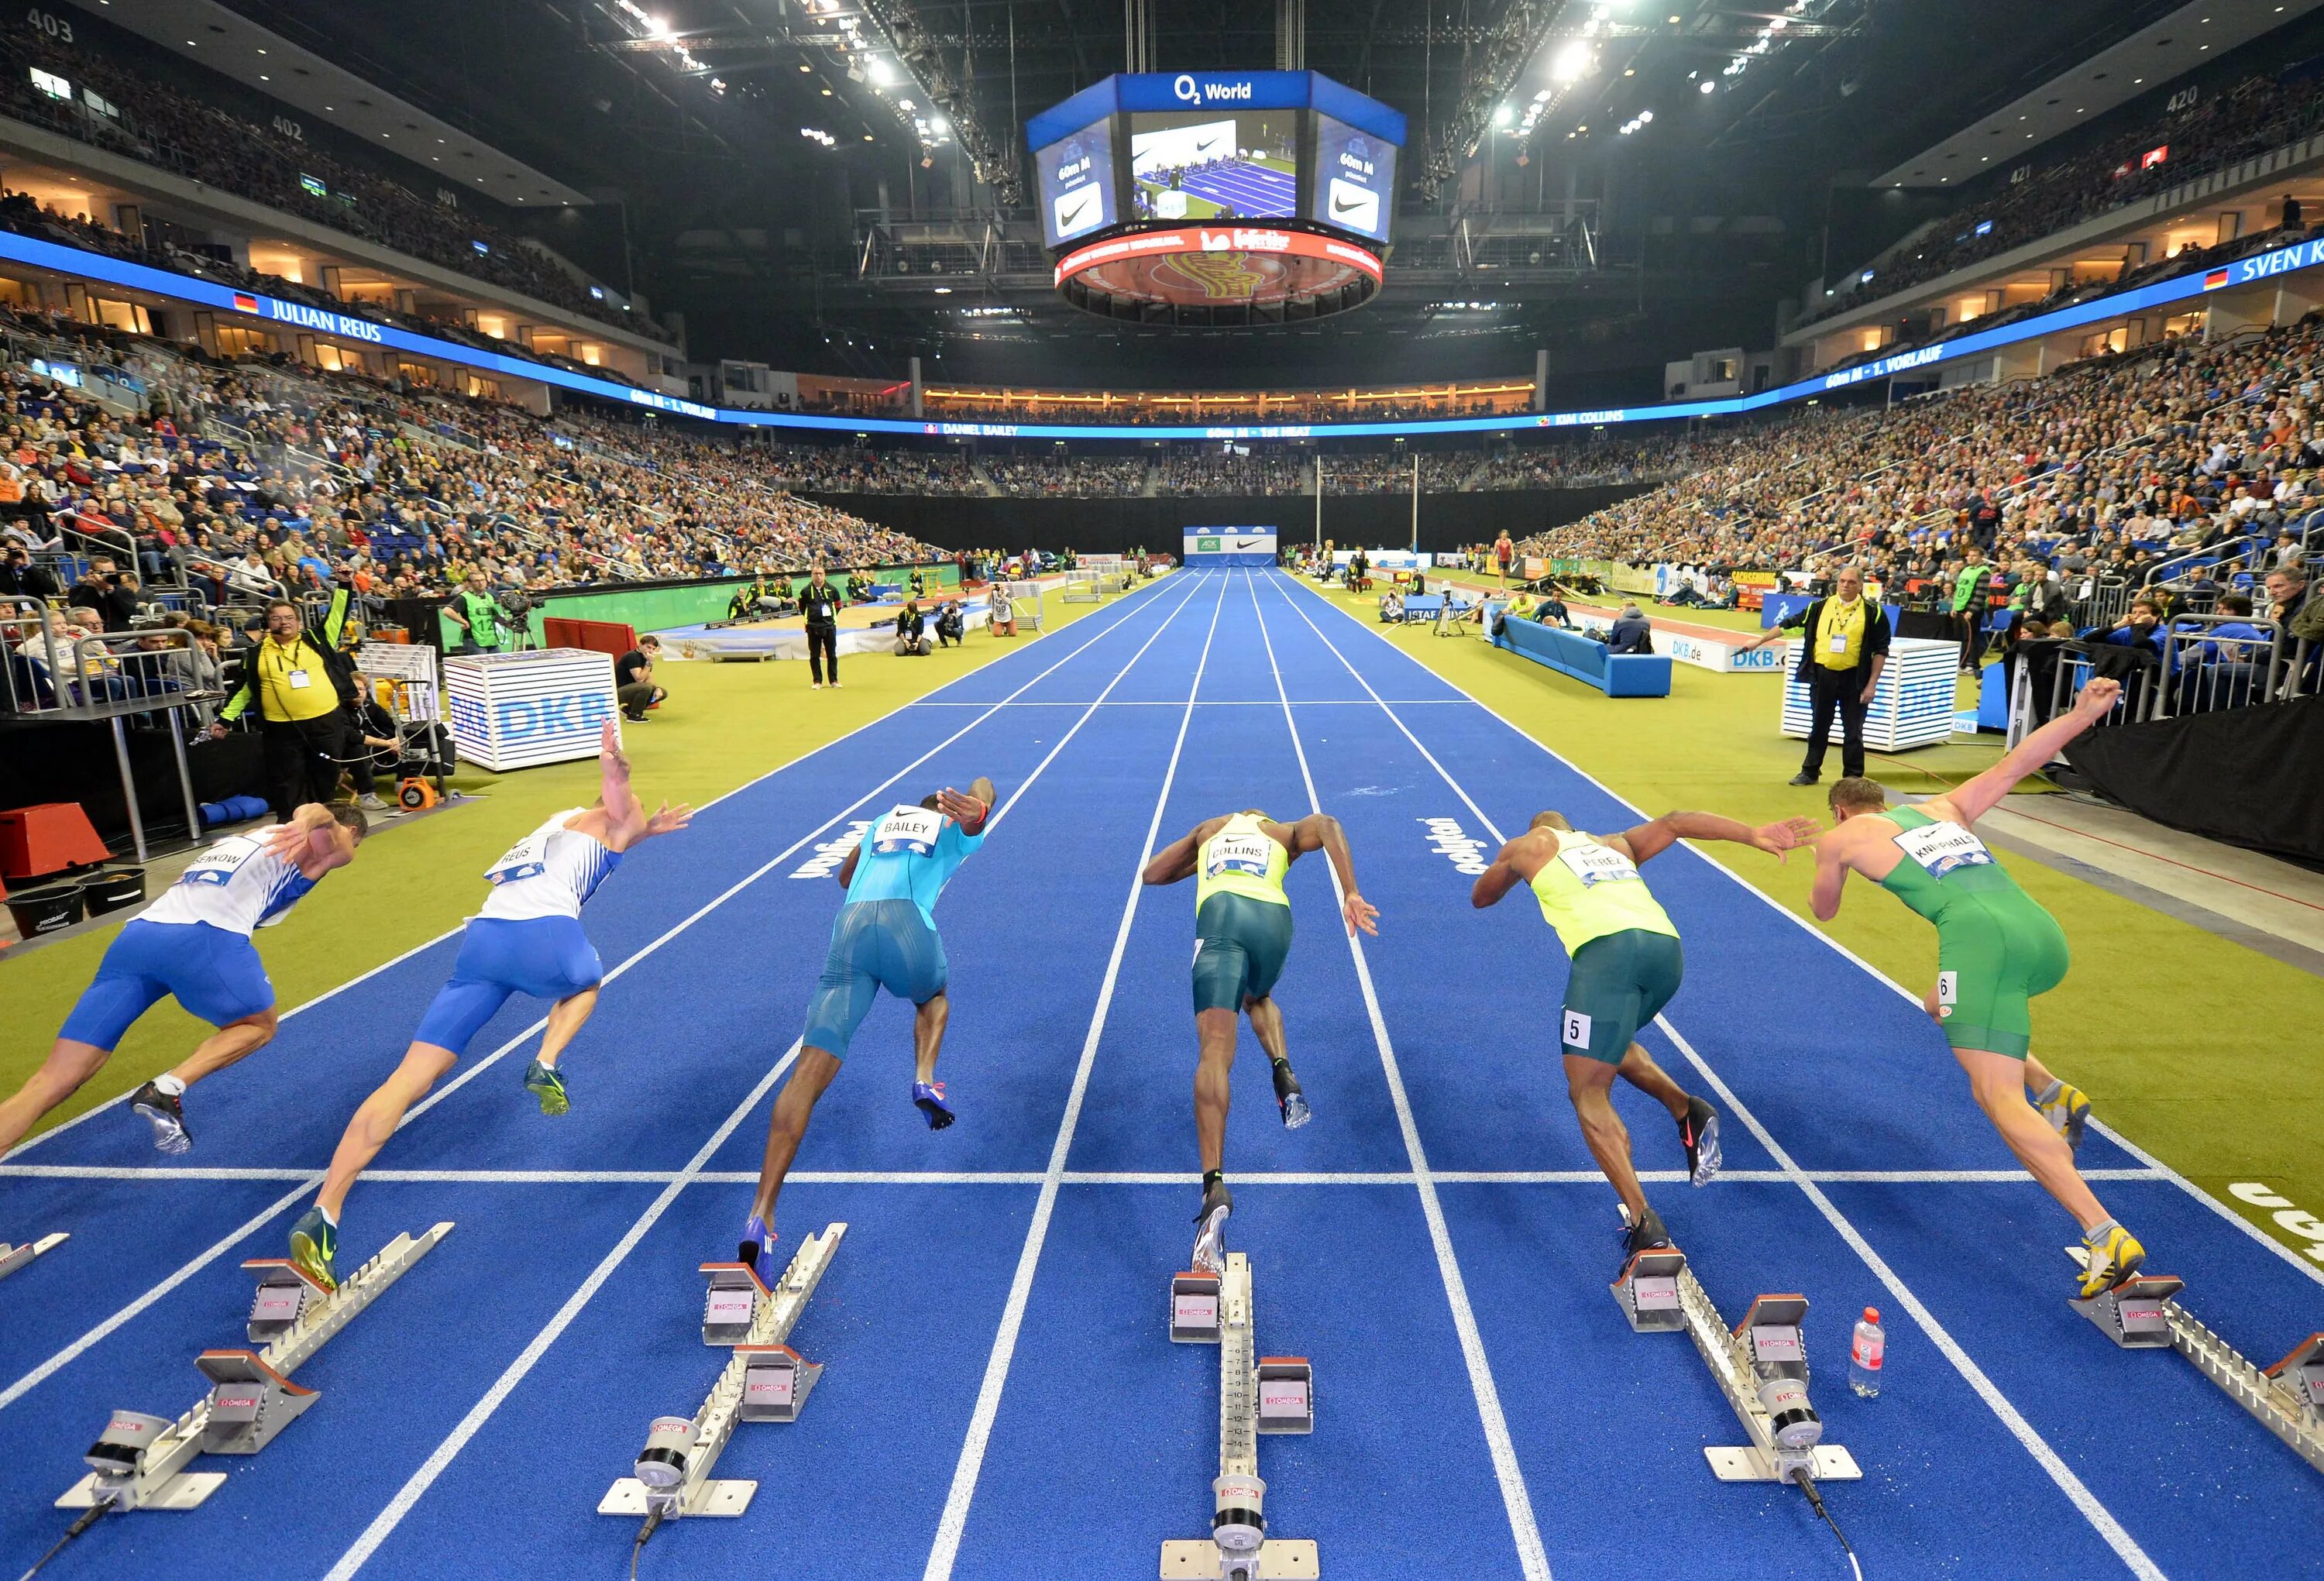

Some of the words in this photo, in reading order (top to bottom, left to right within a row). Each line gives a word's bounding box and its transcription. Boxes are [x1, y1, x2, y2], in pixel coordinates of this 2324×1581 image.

[28, 8, 73, 43] 403
[1205, 82, 1251, 99] World
[2167, 85, 2198, 112] 420
[273, 115, 302, 141] 402
[1058, 163, 1080, 180] 60m
[1081, 156, 1091, 170] M
[1339, 153, 1363, 171] 60m
[1363, 161, 1373, 175] M
[2010, 164, 2031, 184] 421
[436, 187, 458, 208] 401
[2241, 246, 2303, 280] SVEN
[272, 299, 335, 332] JULIAN
[339, 316, 382, 342] REUS
[1826, 371, 1850, 388] 60m
[1851, 367, 1863, 382] M
[1873, 362, 1883, 375] 1.
[1886, 344, 1944, 373] VORLAUF
[1556, 413, 1577, 425] KIM
[1580, 410, 1624, 424] COLLINS
[943, 423, 981, 435] DANIEL
[983, 424, 1018, 436] BAILEY
[1236, 427, 1250, 438] M
[1281, 426, 1310, 437] HEAT
[1590, 430, 1608, 441] 210
[1731, 571, 1776, 585] SACHSENRING
[1408, 610, 1436, 620] ISTAF
[478, 619, 494, 631] 12
[1673, 640, 1701, 661] DKB.de
[497, 693, 610, 740] DKB
[1954, 722, 1973, 731] DKB
[884, 822, 929, 834] BAILEY
[501, 847, 531, 864] REUS
[1213, 847, 1262, 858] COLLINS
[1941, 978, 1948, 995] 6
[1570, 1019, 1580, 1040] 5
[1232, 1488, 1255, 1497] OMEGA
